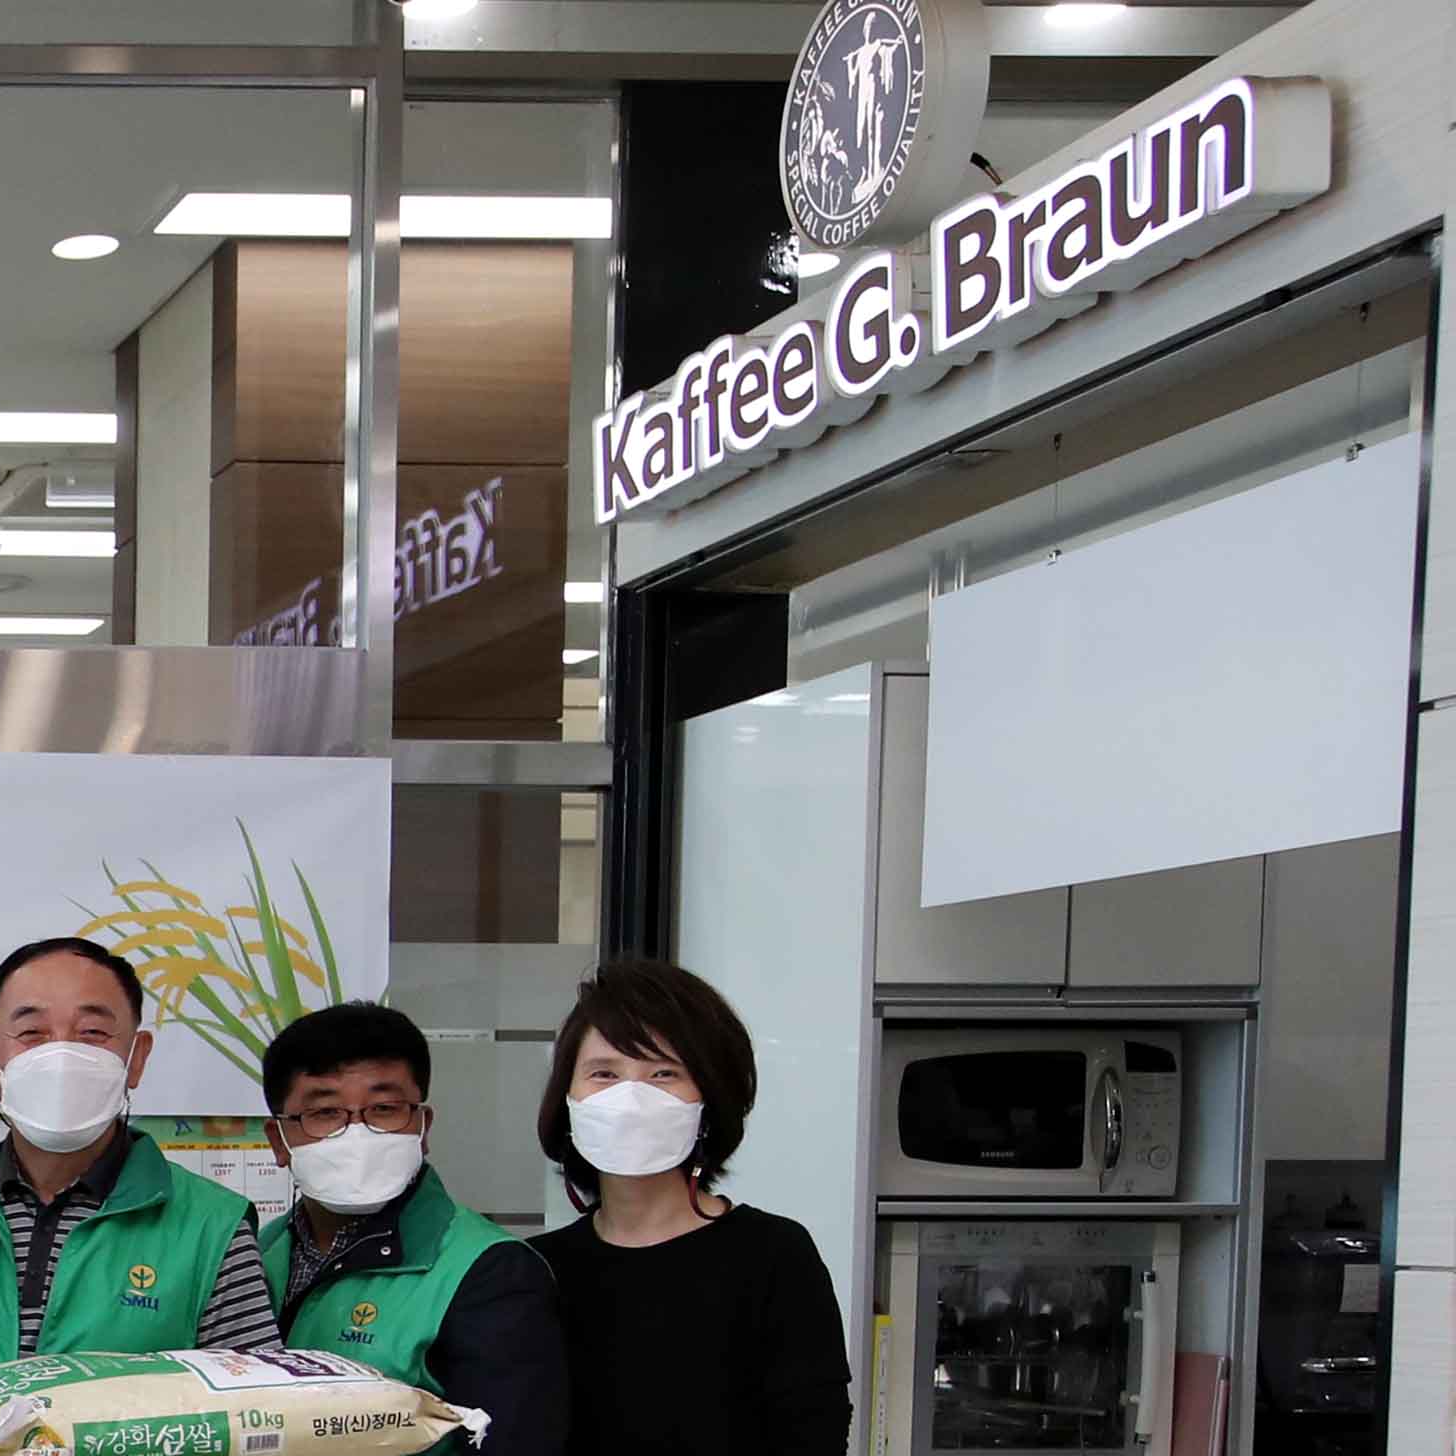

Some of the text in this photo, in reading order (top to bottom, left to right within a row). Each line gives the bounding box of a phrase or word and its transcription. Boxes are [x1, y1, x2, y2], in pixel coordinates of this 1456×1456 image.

[794, 6, 844, 105] KAFFEE
[788, 68, 925, 245] SPECIAL COFFEE QUALITY
[597, 84, 1250, 520] Kaffee G. Braun
[236, 1408, 286, 1430] 10kg
[312, 1412, 417, 1436] 망월(신)정미소
